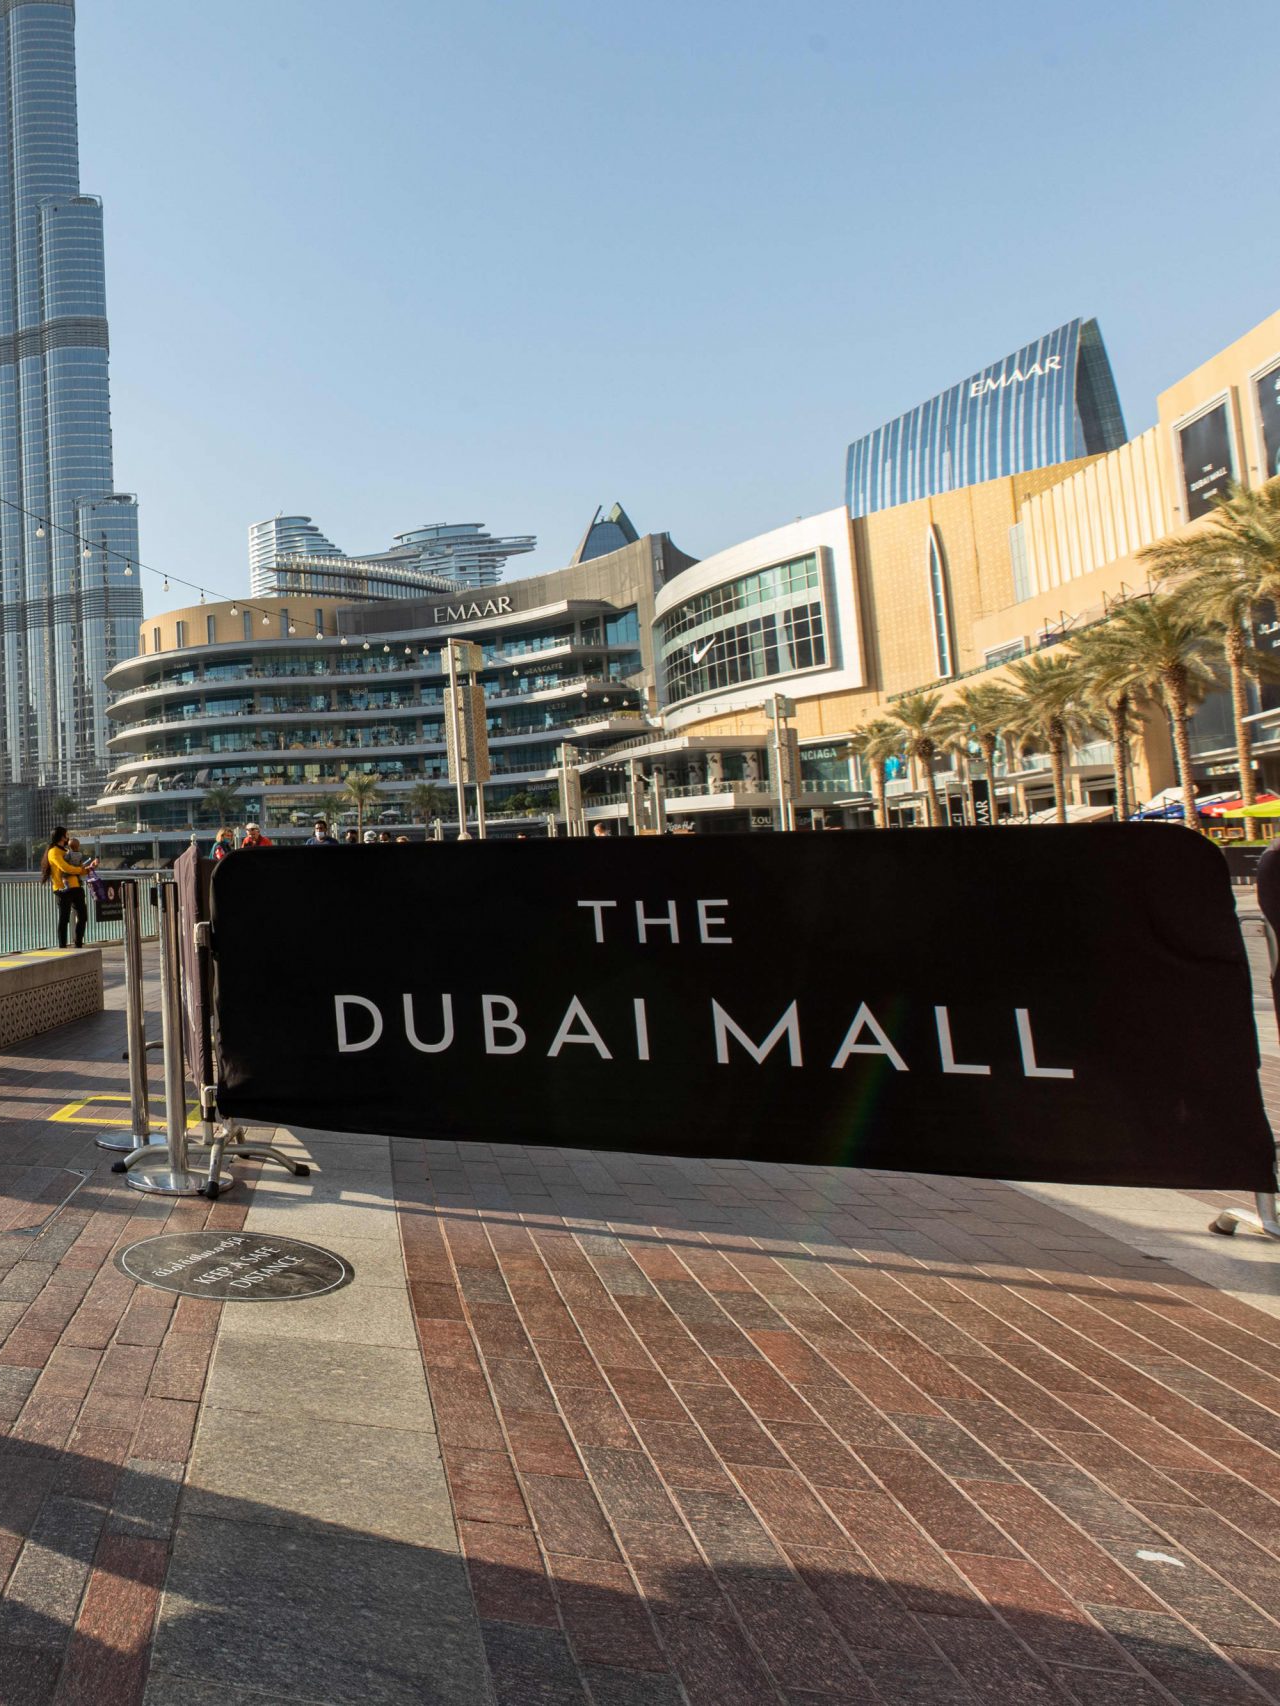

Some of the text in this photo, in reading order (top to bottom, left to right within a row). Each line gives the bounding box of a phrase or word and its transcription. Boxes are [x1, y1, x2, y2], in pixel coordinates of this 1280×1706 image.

[969, 355, 1062, 398] EMAAR
[434, 596, 513, 624] EMAAR
[801, 748, 838, 761] NCIAGA
[975, 800, 990, 826] AAR
[576, 898, 733, 944] THE
[334, 994, 1075, 1079] DUBAI MALL
[193, 1266, 233, 1285] KEEP
[240, 1246, 281, 1263] SAFE
[229, 1254, 305, 1288] DISTANCE
